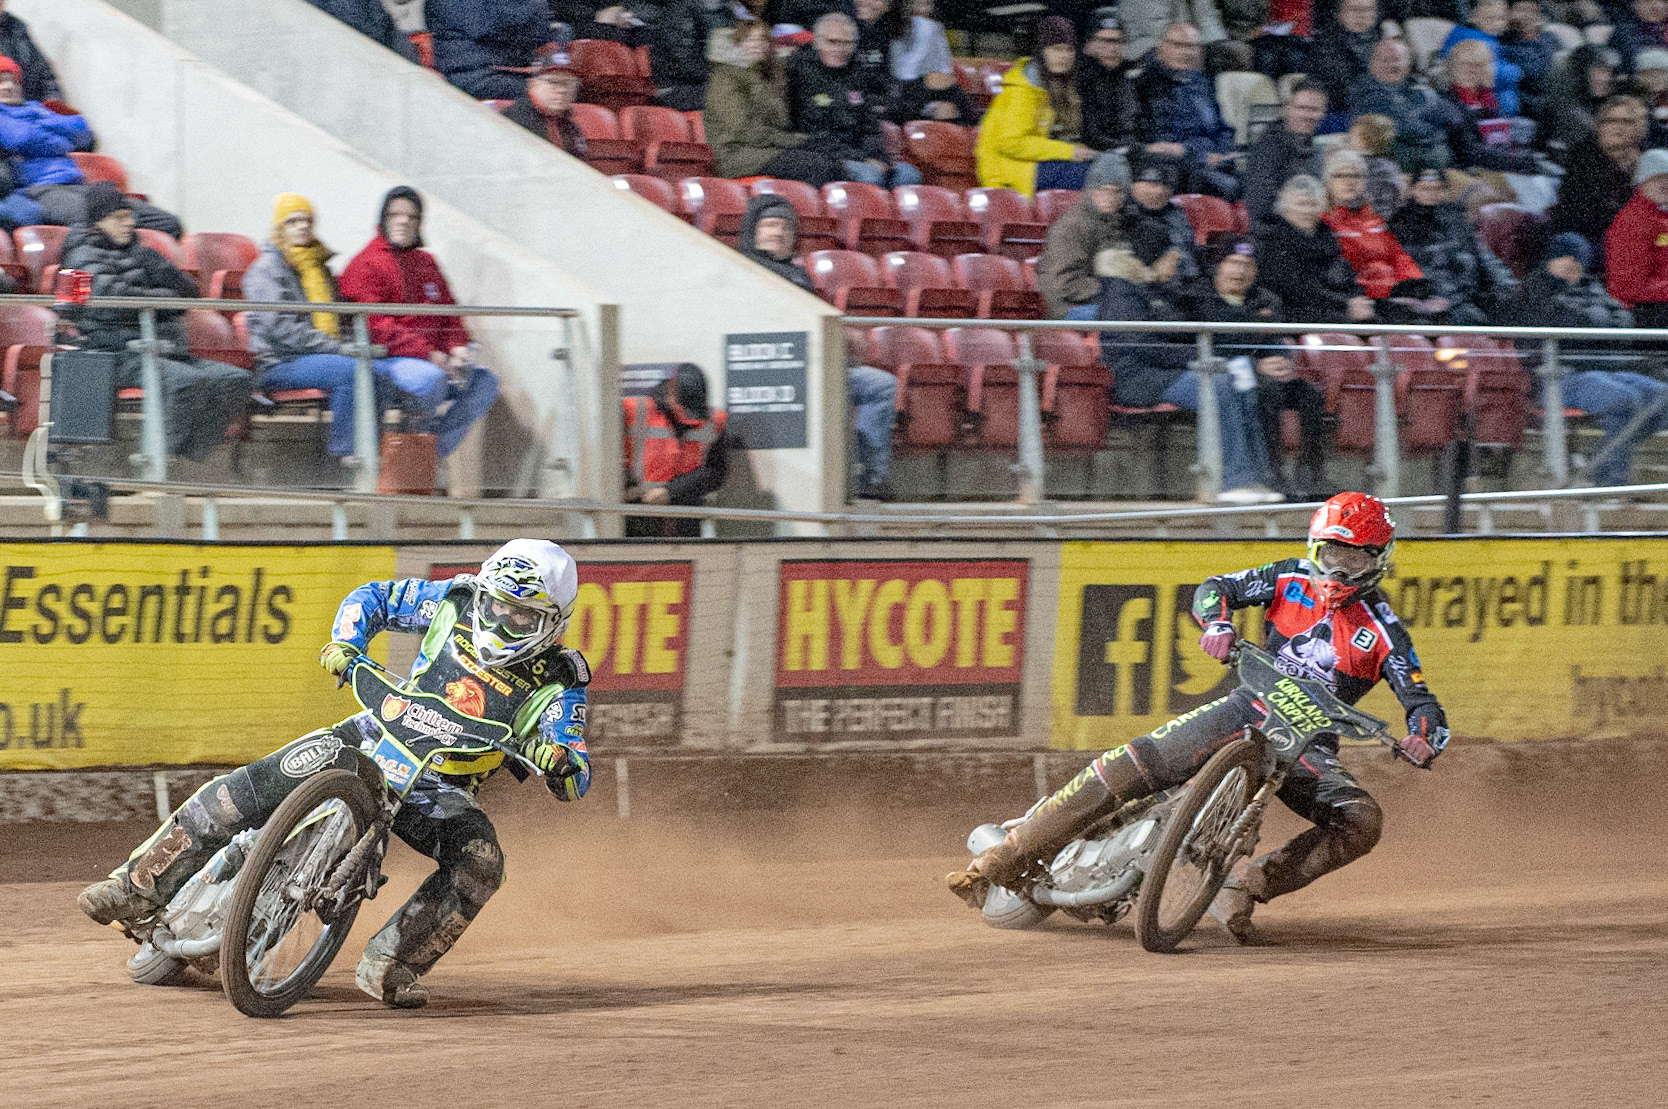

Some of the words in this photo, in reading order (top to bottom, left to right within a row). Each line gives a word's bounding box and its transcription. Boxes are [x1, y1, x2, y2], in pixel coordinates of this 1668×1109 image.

[1, 565, 293, 646] Essentials
[563, 580, 683, 674] OTE
[785, 577, 1018, 671] HYCOTE
[1386, 560, 1552, 643] prayed
[1564, 559, 1603, 626] in
[1620, 559, 1668, 626] th
[407, 703, 464, 735] Chiltern
[1267, 692, 1317, 732] CARPETS
[1274, 678, 1332, 728] KIRKLAND
